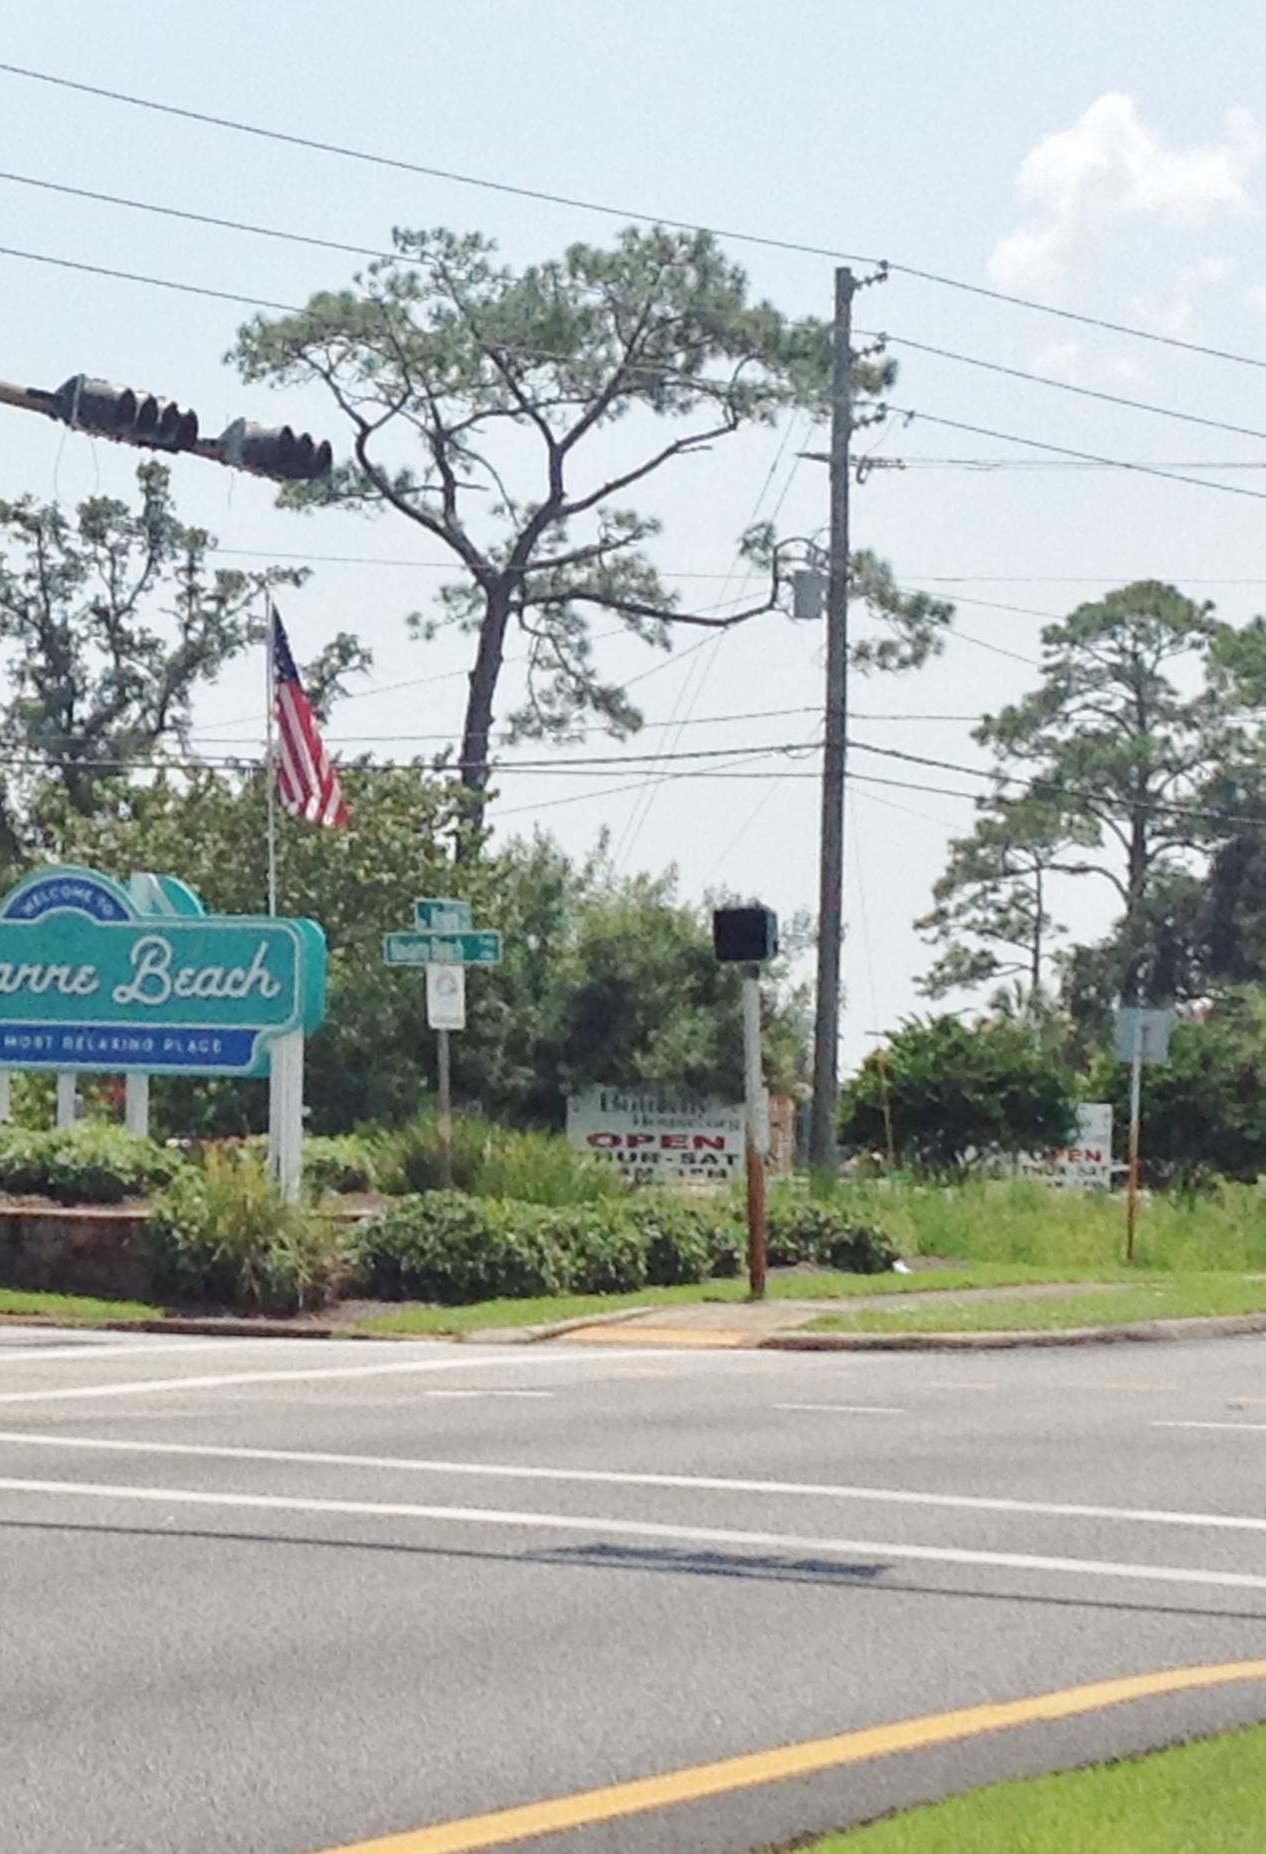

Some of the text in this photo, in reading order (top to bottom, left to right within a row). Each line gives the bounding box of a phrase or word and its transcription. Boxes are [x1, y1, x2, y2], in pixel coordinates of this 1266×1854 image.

[22, 885, 115, 916] WELCOME TO
[112, 934, 282, 1006] Beach
[3, 1034, 54, 1049] MOST
[62, 1036, 155, 1052] RELAXING
[163, 1038, 222, 1054] PLACE
[586, 1132, 725, 1150] OPEN
